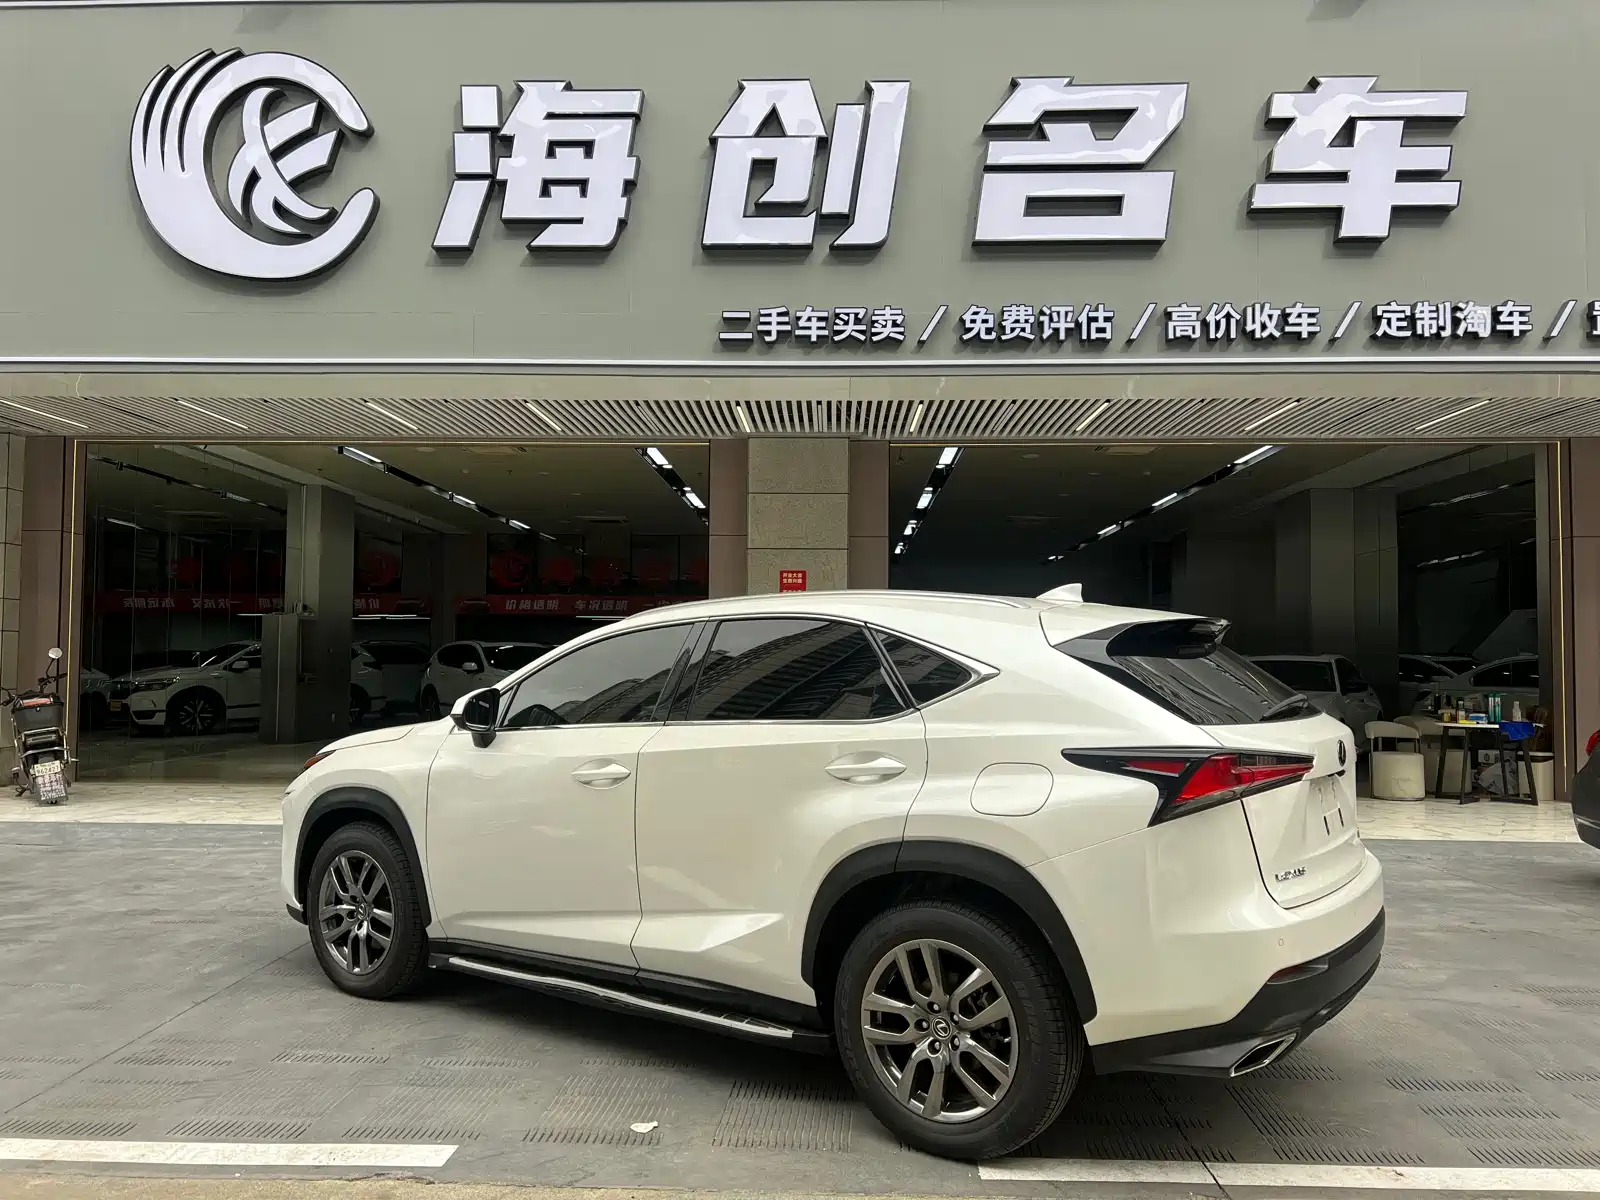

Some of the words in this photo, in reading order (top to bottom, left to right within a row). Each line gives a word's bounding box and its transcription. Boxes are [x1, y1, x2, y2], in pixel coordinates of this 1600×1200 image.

[432, 76, 1468, 250] 海创名车
[718, 305, 906, 343] 二手车买卖
[961, 303, 1115, 342] 免费评估
[1165, 302, 1322, 341] 高价收车
[1374, 300, 1533, 340] 定制淘车
